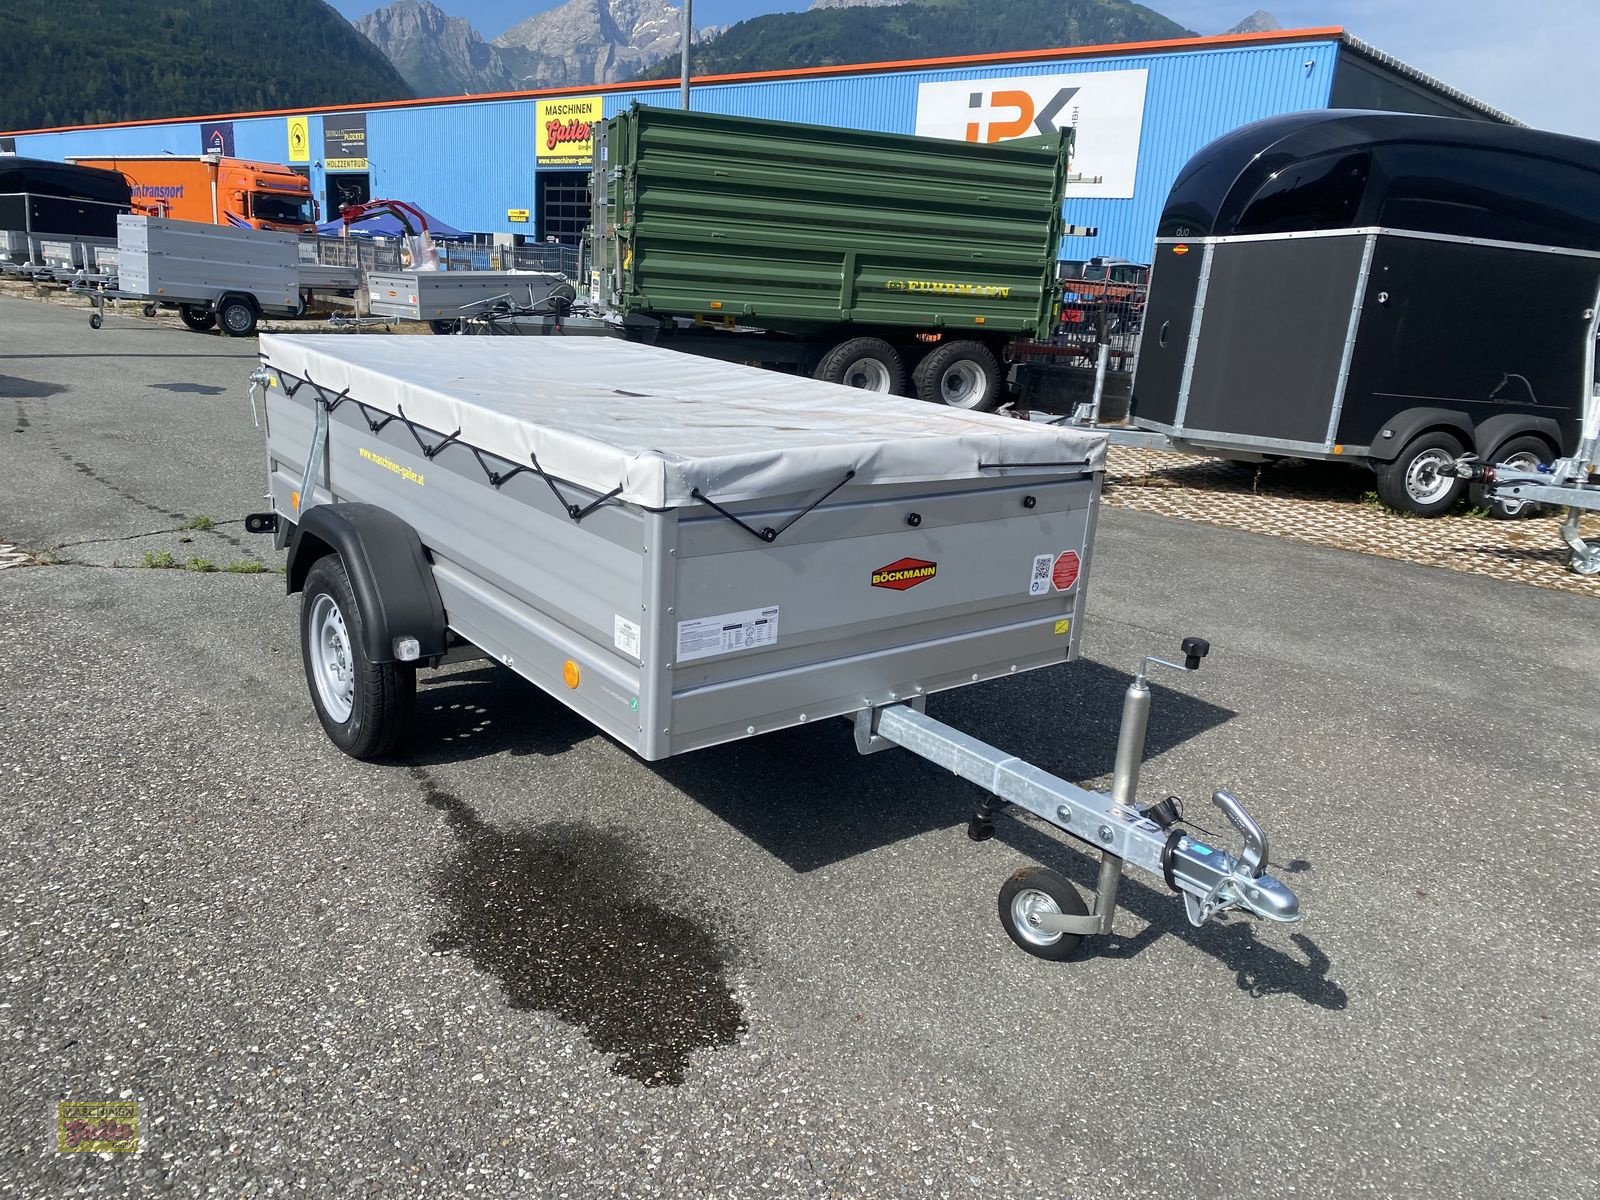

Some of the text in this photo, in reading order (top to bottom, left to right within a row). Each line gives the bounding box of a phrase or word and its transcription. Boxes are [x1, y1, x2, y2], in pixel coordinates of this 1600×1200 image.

[545, 103, 592, 116] MASCHINEN
[545, 118, 592, 150] Gailer
[326, 159, 366, 168] HOLZZENTRUM
[537, 156, 593, 165] www.maschinen-gailer
[142, 183, 184, 199] transport
[1176, 226, 1190, 236] duo
[907, 281, 1010, 298] FUHRMANN
[358, 447, 425, 486] www.maschinen-gailer.at
[872, 566, 936, 584] BÖCKMANN
